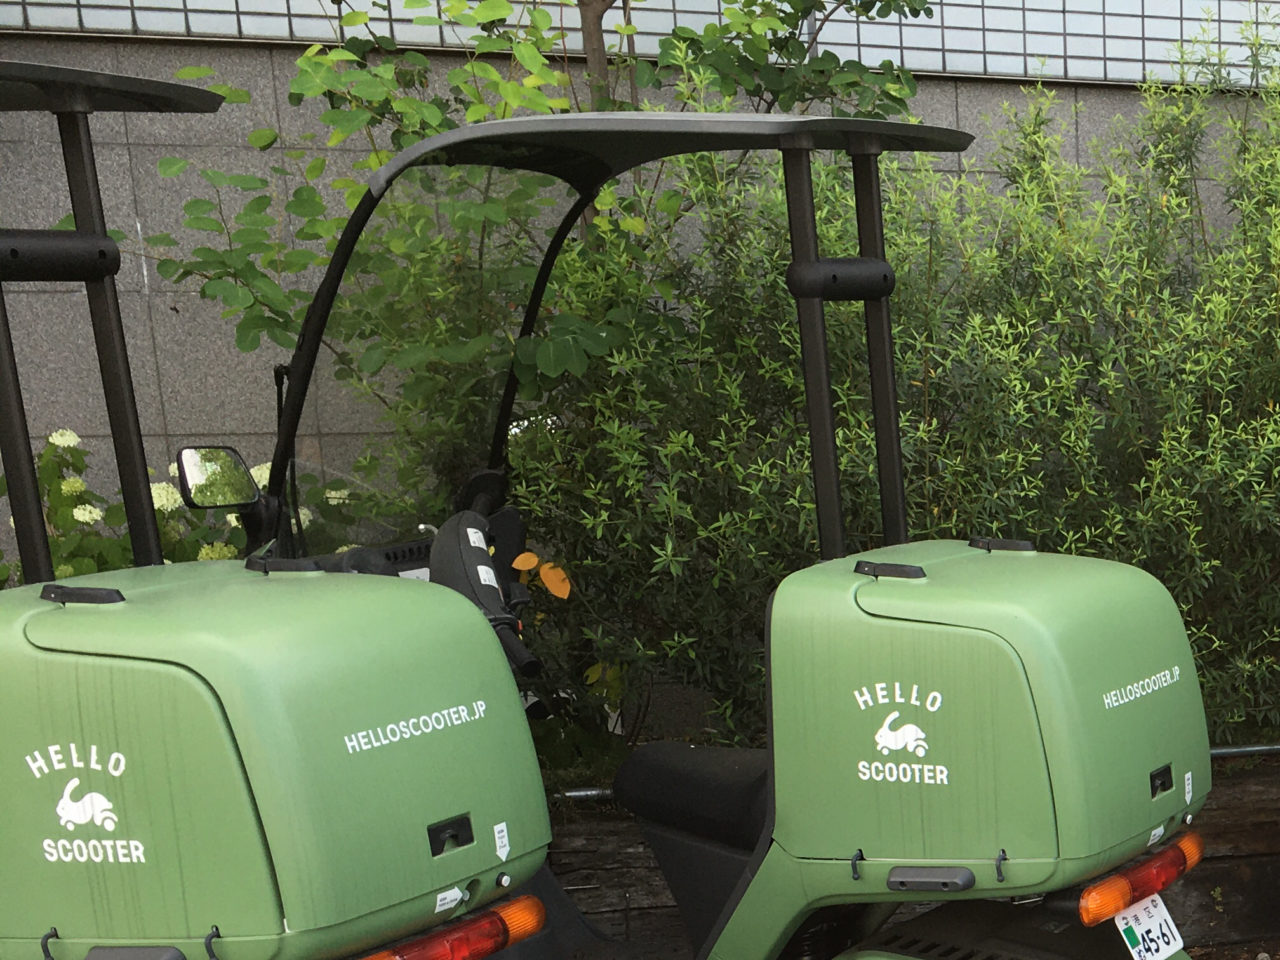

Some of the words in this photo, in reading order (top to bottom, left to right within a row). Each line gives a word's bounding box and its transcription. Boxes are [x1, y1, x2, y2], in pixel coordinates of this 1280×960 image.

[853, 681, 943, 712] HELLO
[1103, 665, 1181, 709] HELLOSCOOTER.JP
[344, 700, 487, 754] HELLOSCOOTER.JP
[25, 743, 126, 779] HELLO
[858, 760, 949, 785] SCOOTER
[43, 838, 146, 864] SCOOTER
[1140, 918, 1177, 957] 45-61
